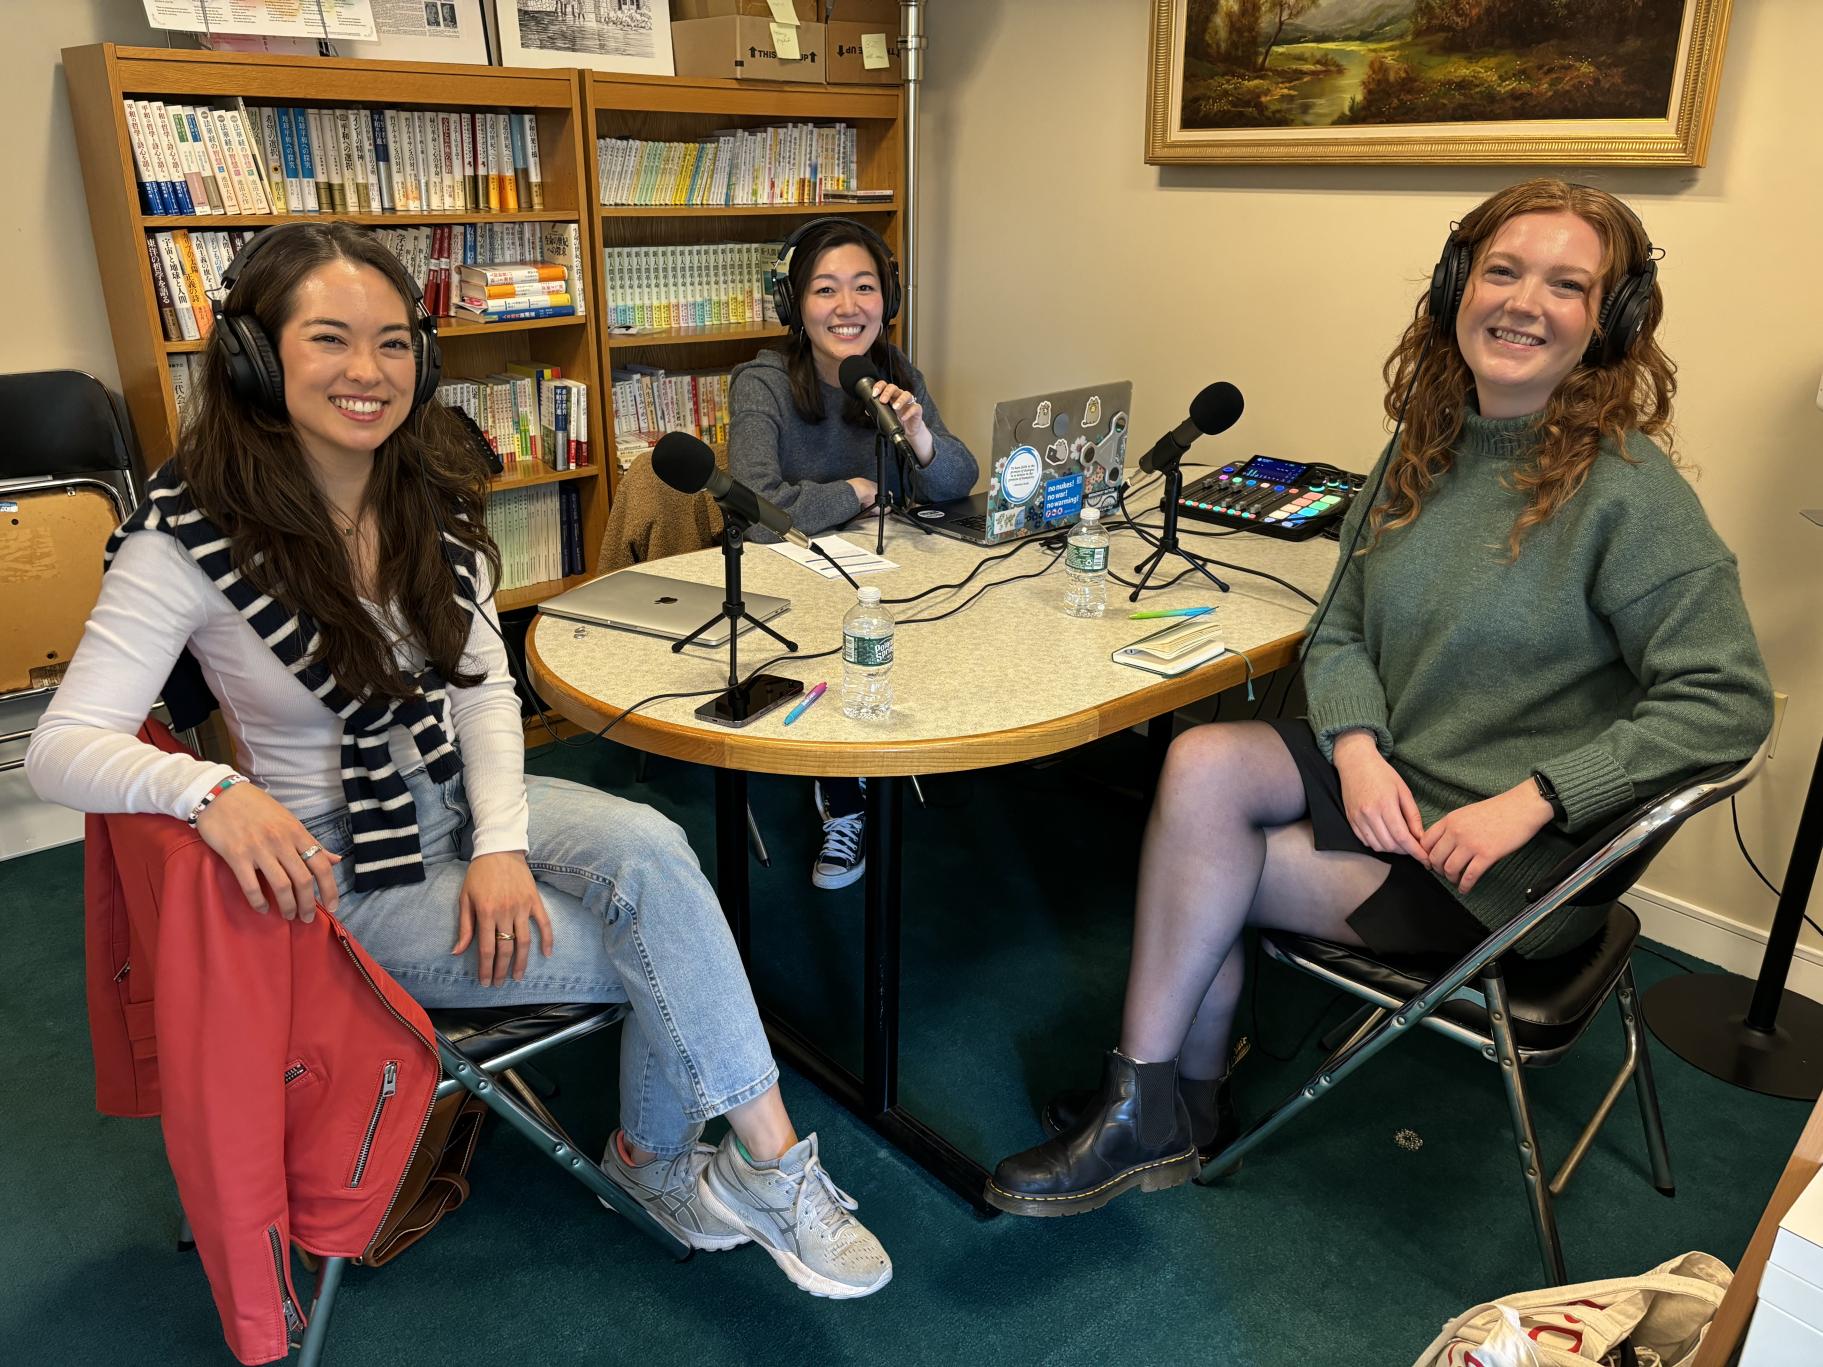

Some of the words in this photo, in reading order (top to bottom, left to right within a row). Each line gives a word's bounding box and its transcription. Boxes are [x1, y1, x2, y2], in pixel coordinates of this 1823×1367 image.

[758, 50, 777, 59] THIS
[127, 103, 150, 173] 平和の哲学と詩心を語る
[141, 105, 165, 174] 平和の哲学と詩心を語る
[155, 105, 180, 174] 平和の哲学と詩心を語る
[203, 119, 224, 167] 法華経の智慧
[221, 176, 233, 202] 池田大作
[219, 122, 240, 170] 法華経の智慧
[236, 179, 250, 205] 池田大作
[232, 122, 253, 169] 法華経の智慧
[250, 177, 263, 205] 池田大作
[341, 122, 353, 171] 平和への選択
[352, 117, 364, 162] インドの精神
[148, 238, 170, 304] 東洋の哲学を語る
[162, 237, 188, 304] 宇宙と地球と人間
[186, 273, 200, 303] 正義の詩
[1047, 493, 1055, 501] no
[1055, 490, 1068, 499] war!
[1053, 494, 1080, 506] warming!
[1056, 479, 1075, 490] nukes!
